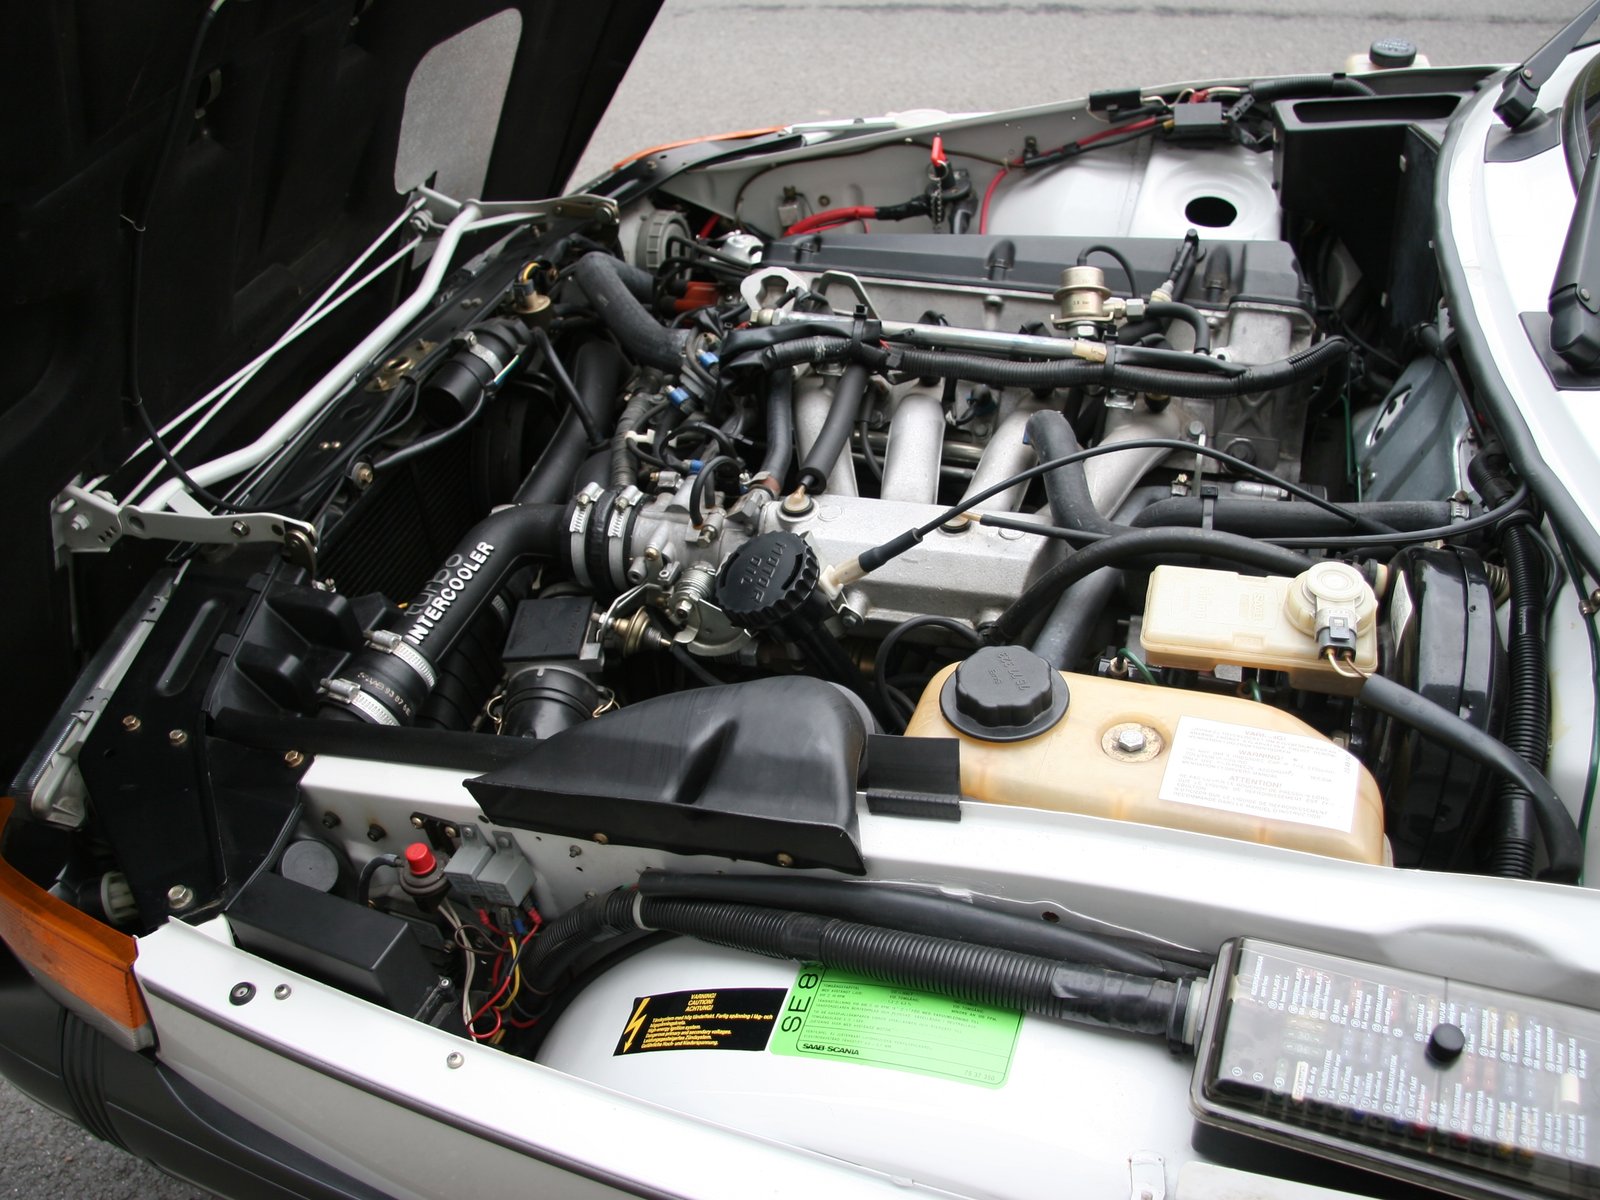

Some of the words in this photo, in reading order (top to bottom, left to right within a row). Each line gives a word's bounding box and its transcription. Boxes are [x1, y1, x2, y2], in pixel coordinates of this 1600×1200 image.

[404, 541, 495, 645] INTERCOOLER
[741, 555, 763, 586] OIL
[753, 541, 787, 604] MOTOR
[1238, 750, 1284, 761] WARNING!
[1229, 775, 1282, 788] ATTENTION!
[782, 972, 819, 1032] SE8
